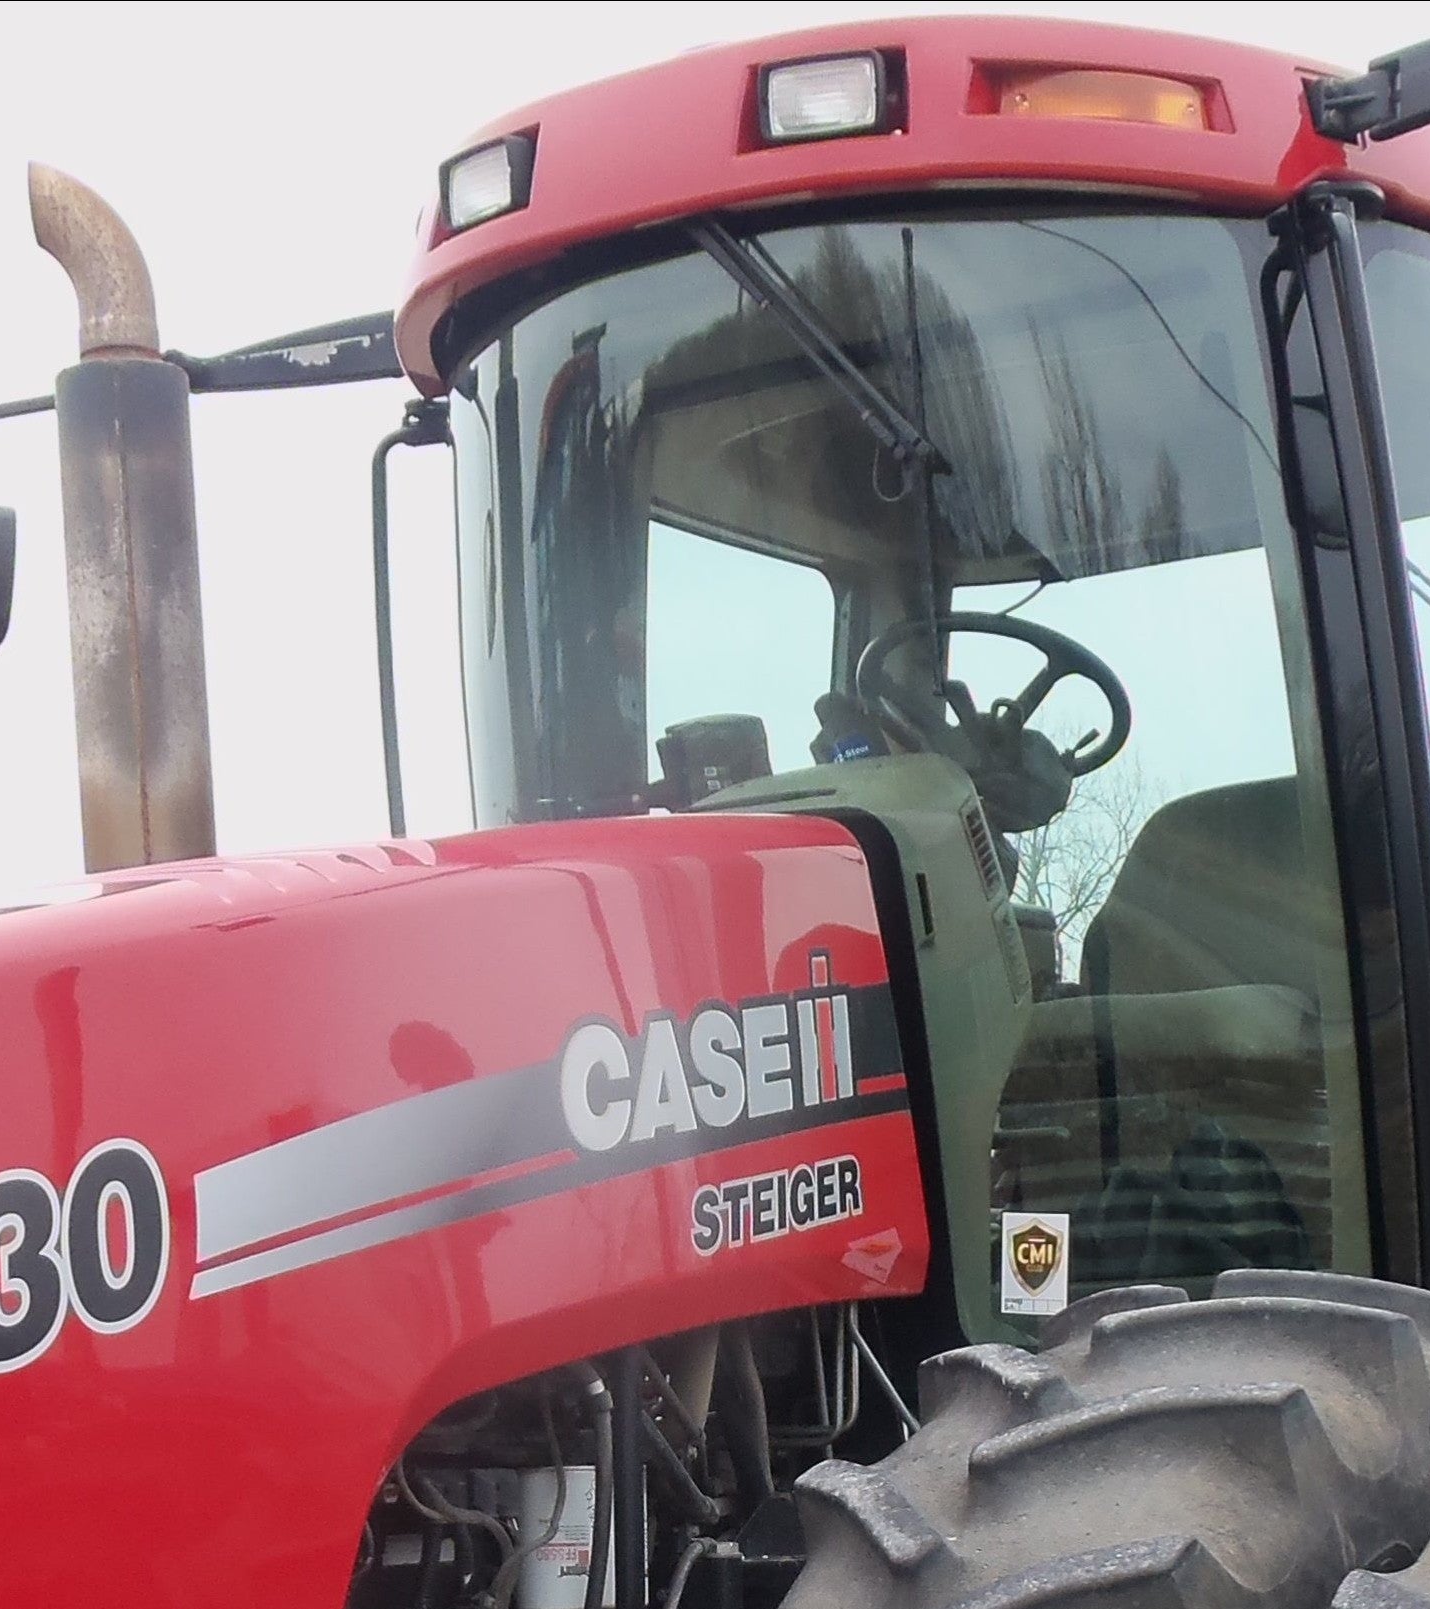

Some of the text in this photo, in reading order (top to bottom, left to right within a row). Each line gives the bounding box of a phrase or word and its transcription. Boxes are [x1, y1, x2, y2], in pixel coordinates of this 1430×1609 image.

[560, 1003, 794, 1152] CASE
[690, 1154, 864, 1257] STEIGER
[1017, 1242, 1054, 1265] CMI
